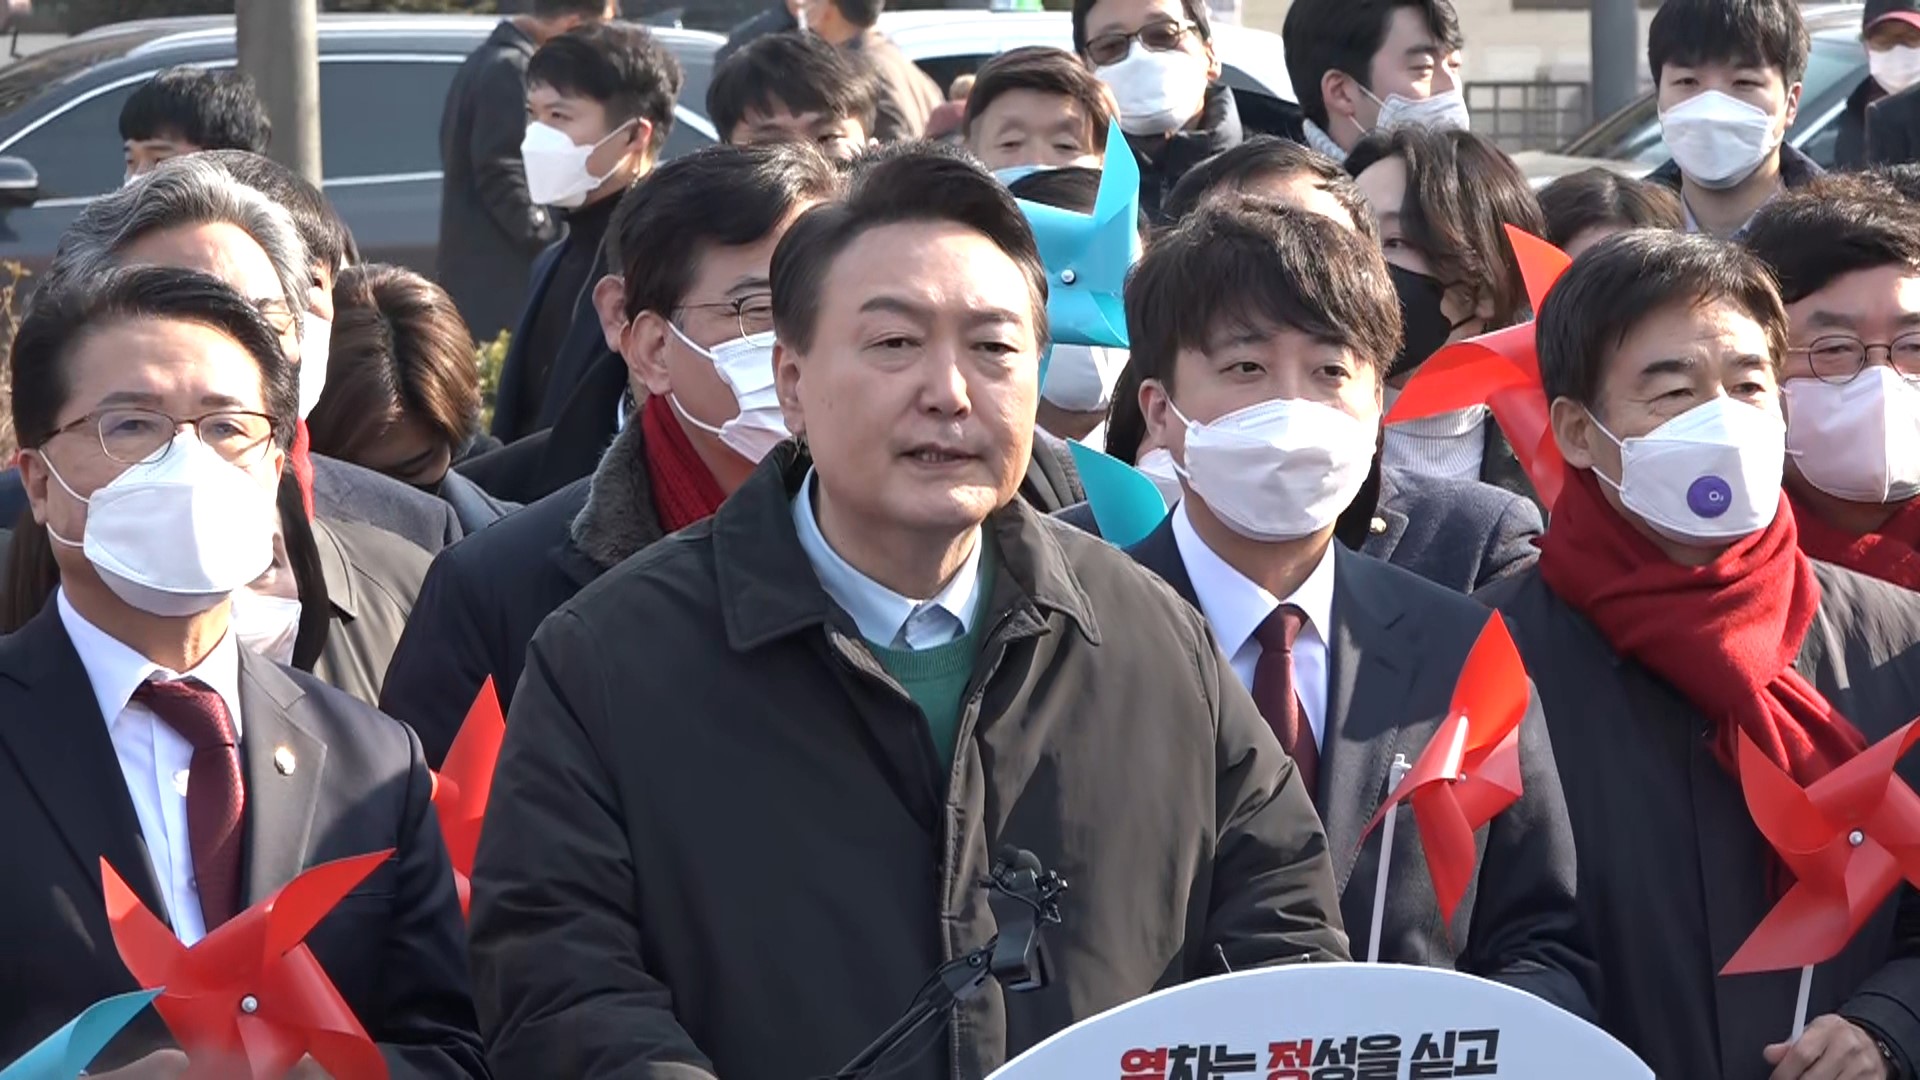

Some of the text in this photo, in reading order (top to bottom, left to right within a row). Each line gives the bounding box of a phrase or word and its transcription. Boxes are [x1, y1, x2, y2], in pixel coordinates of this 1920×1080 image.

[1120, 1029, 1500, 1080] 열차는 정성을 싣고
